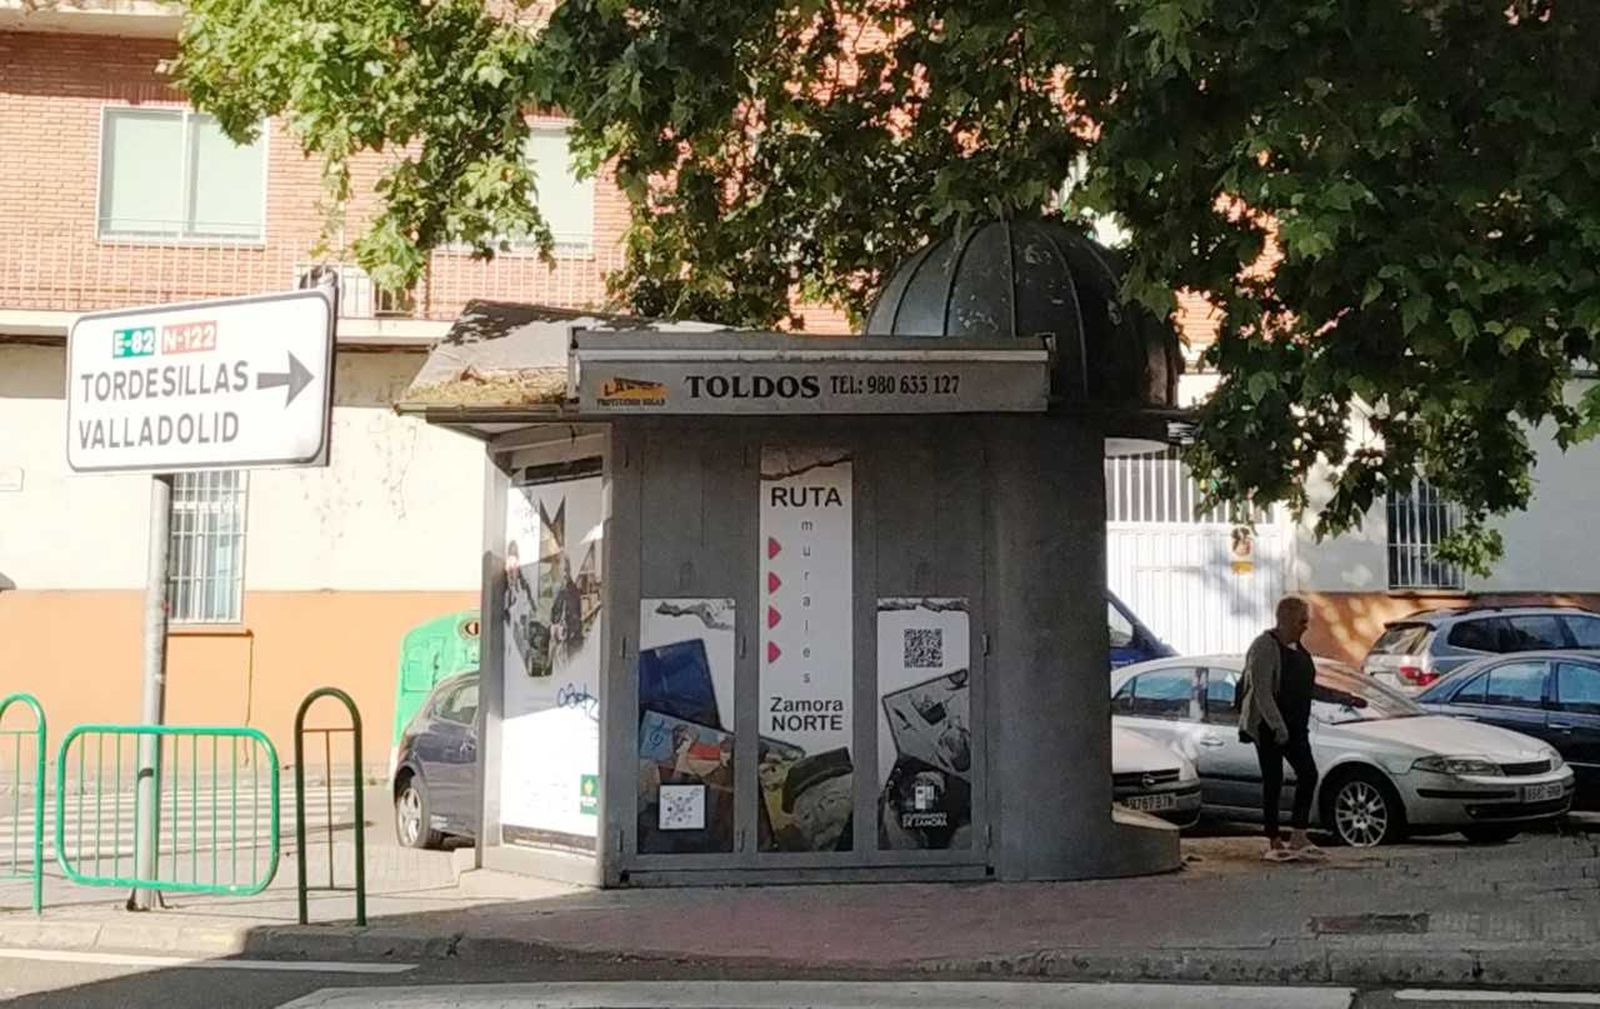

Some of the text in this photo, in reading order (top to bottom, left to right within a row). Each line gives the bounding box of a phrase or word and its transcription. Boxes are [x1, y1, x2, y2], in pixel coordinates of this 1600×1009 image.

[113, 323, 215, 356] E-82 N-122
[81, 360, 249, 403] TORDESILLAS
[684, 375, 820, 399] TOLDOS
[867, 375, 896, 395] 980
[933, 375, 961, 395] 127
[78, 411, 240, 450] VALLADOLID
[771, 486, 842, 508] RUTA
[770, 696, 844, 712] Zamora
[772, 715, 843, 731] NORTE
